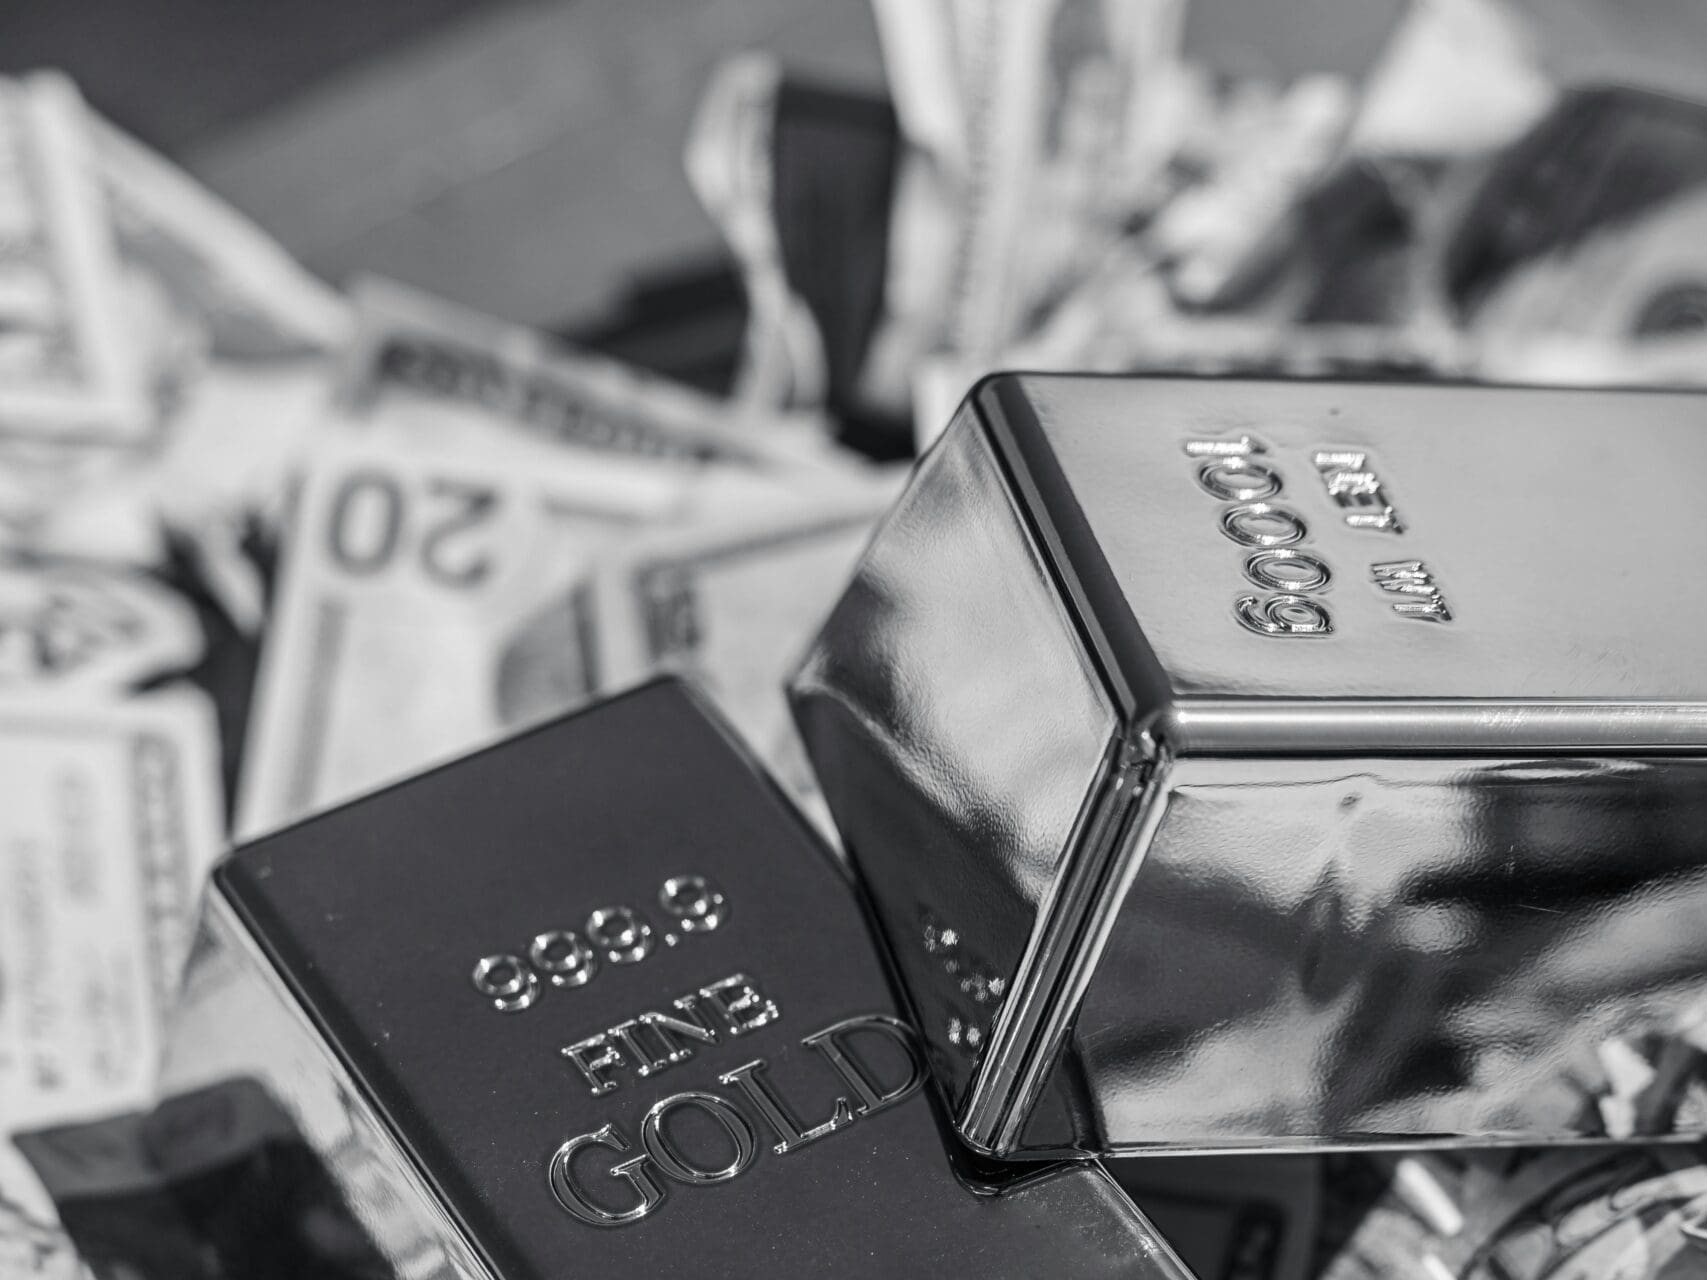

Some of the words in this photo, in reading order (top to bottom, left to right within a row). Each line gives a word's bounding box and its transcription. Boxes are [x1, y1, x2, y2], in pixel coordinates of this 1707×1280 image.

[327, 462, 500, 590] 20
[1184, 436, 1336, 638] 1000g
[1313, 452, 1404, 534] NET
[1370, 560, 1452, 622] WT
[472, 874, 730, 1011] 999.9
[561, 973, 779, 1095] FINE
[547, 1013, 930, 1226] GOLD
